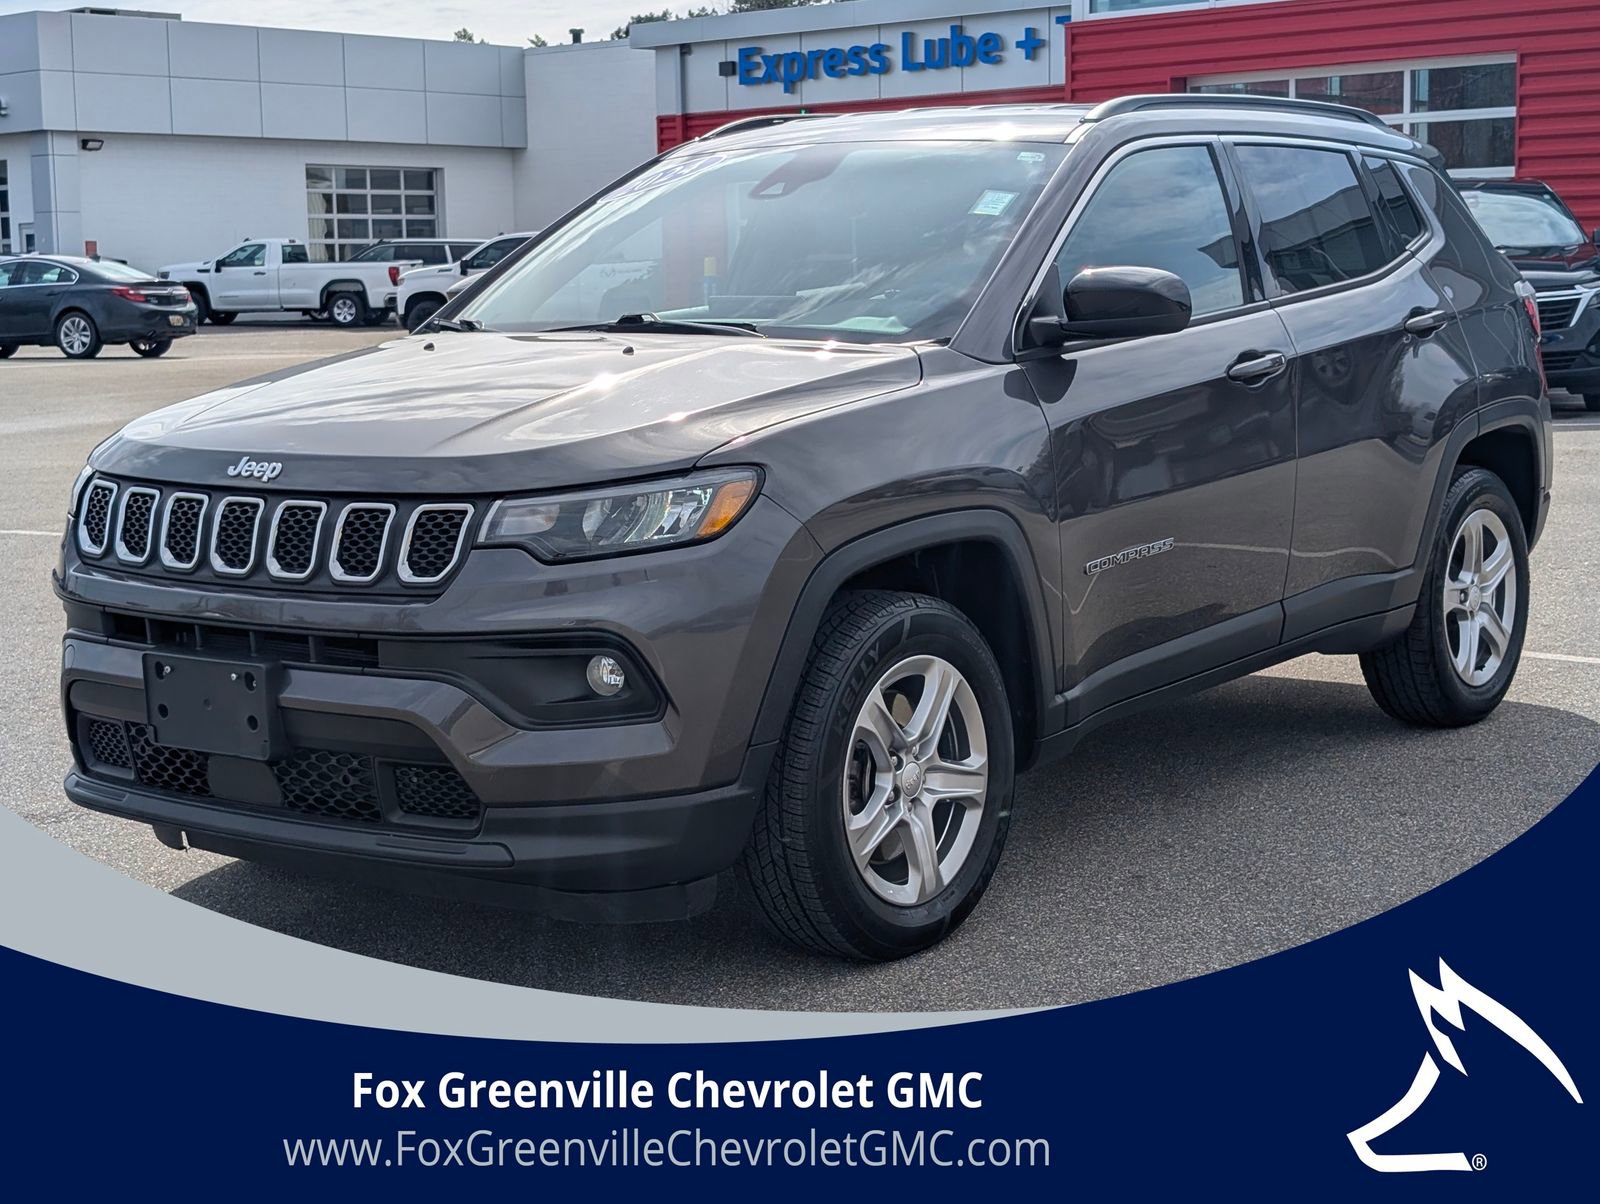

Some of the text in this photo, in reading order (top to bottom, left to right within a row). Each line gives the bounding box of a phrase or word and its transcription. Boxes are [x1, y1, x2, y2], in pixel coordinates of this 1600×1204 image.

[738, 43, 891, 94] Express
[902, 24, 1003, 71] Lube
[227, 456, 283, 482] Jeep
[1086, 537, 1174, 575] COMPASS
[834, 639, 880, 737] KELLY
